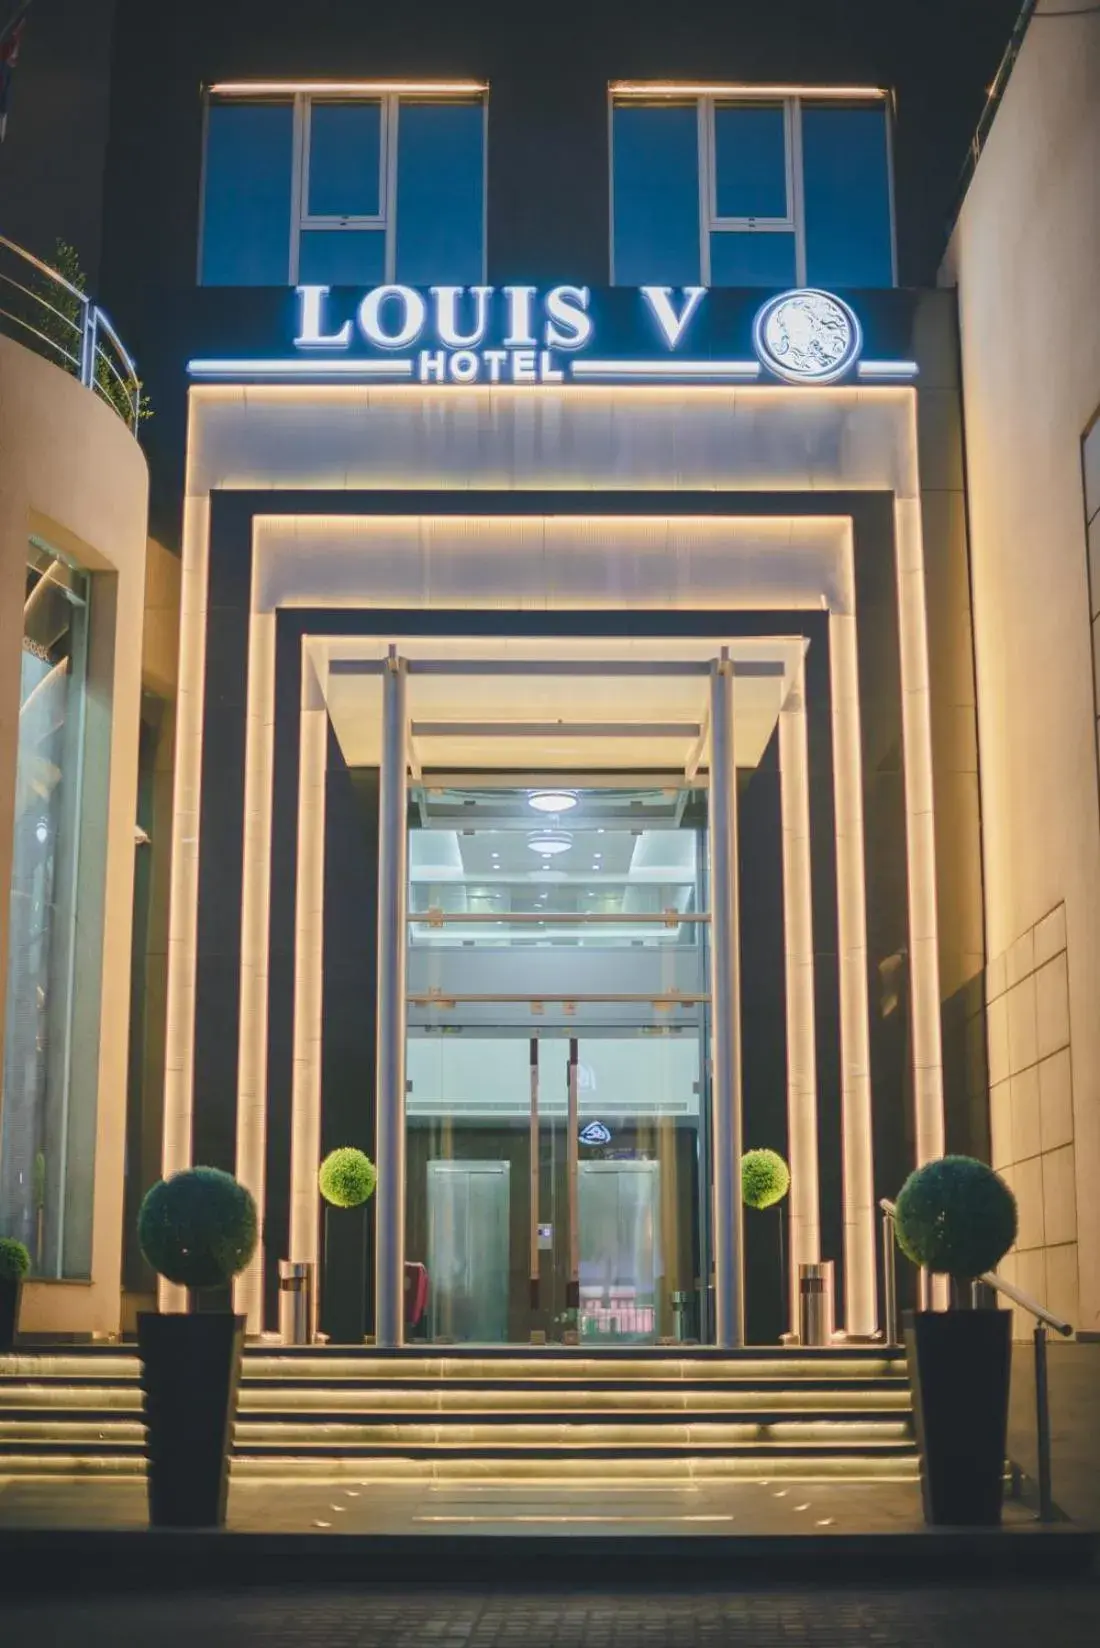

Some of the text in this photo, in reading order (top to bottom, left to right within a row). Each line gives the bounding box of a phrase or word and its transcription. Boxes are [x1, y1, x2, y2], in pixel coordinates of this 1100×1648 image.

[293, 285, 708, 350] LOUIS V
[419, 350, 564, 384] HOTEL
